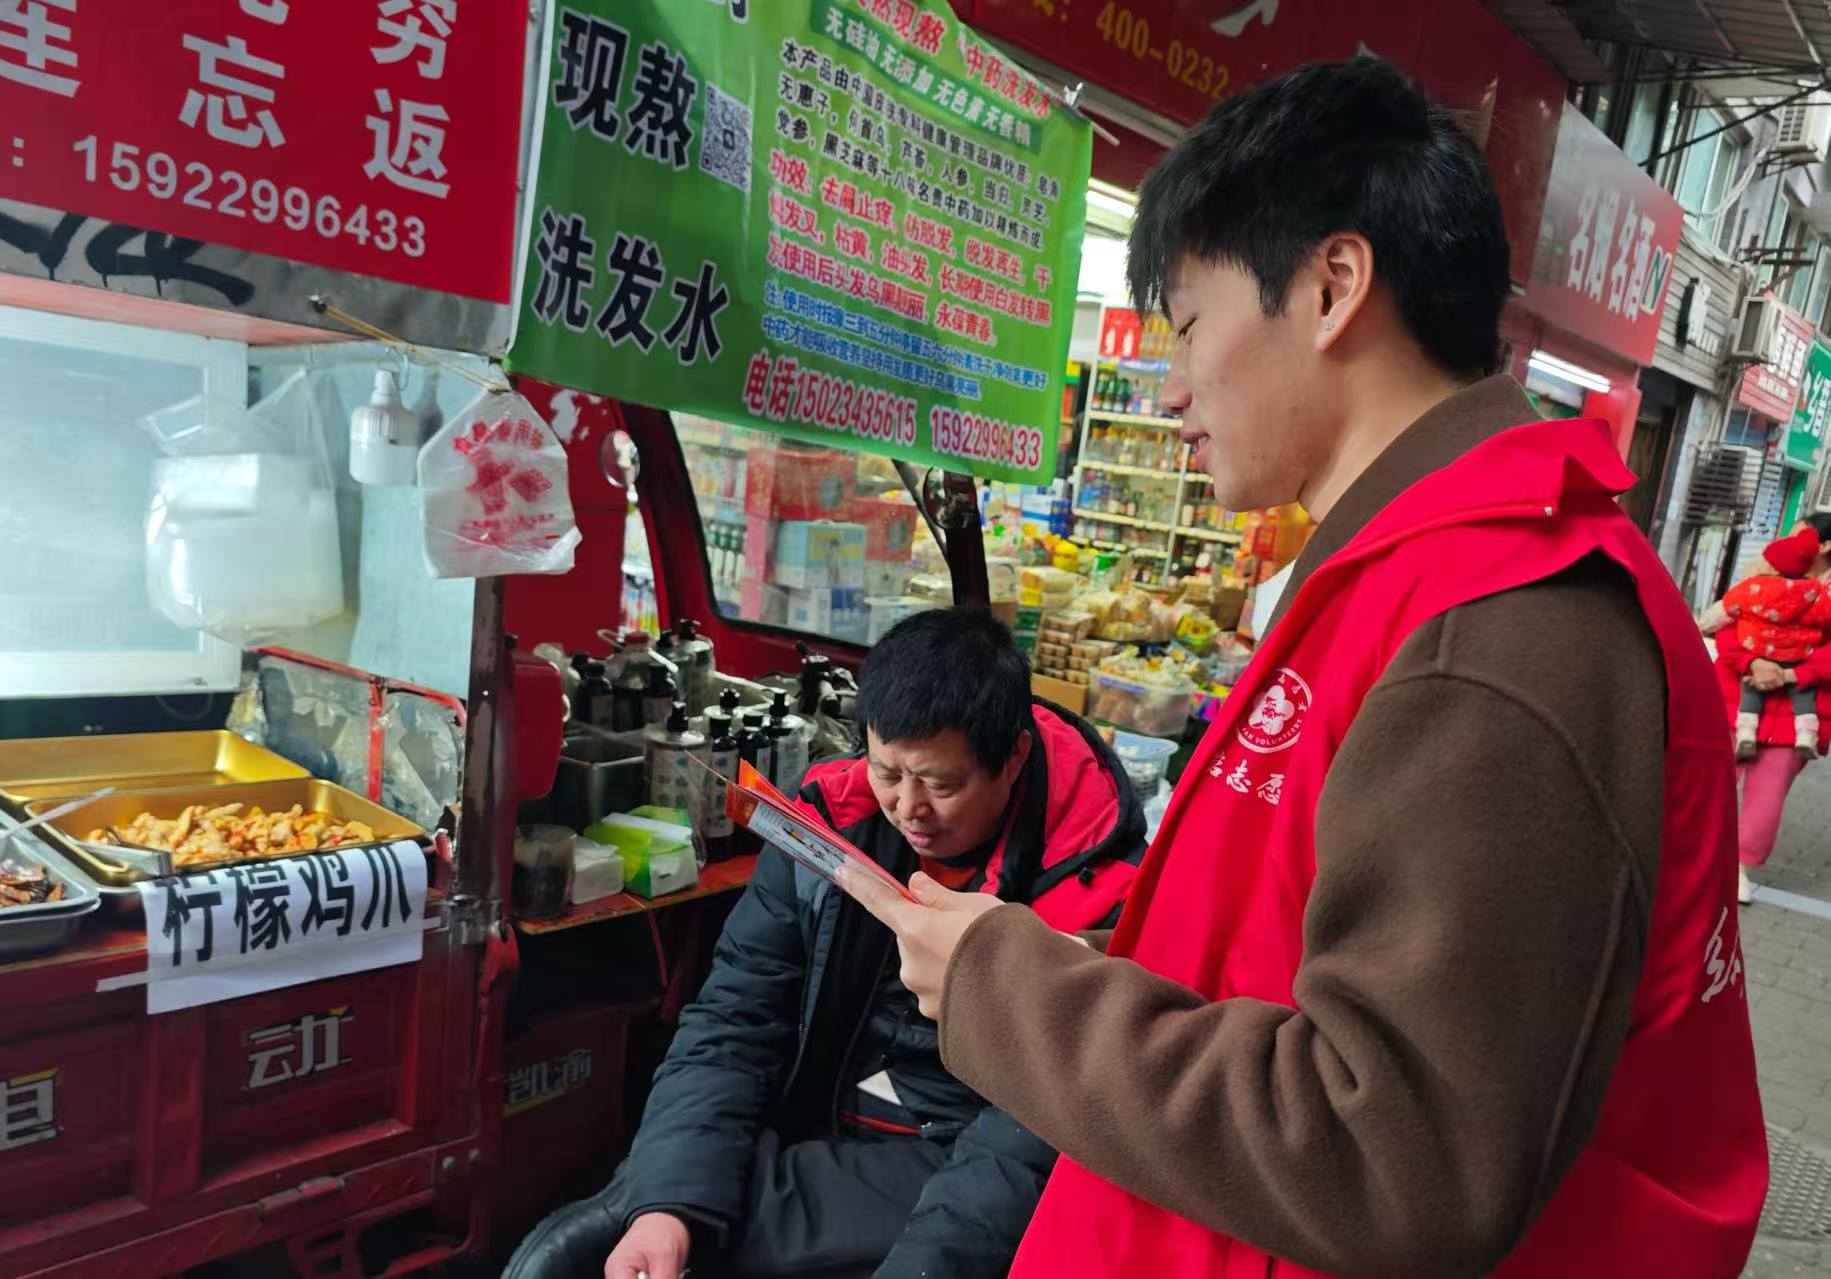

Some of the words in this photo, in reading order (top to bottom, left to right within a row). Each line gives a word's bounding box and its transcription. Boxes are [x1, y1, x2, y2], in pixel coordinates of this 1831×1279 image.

[554, 8, 698, 171] 现熬
[73, 134, 427, 257] 15922996433
[531, 206, 730, 365] 洗发水
[930, 407, 1042, 468] 15922996433
[246, 1006, 354, 1090] 动
